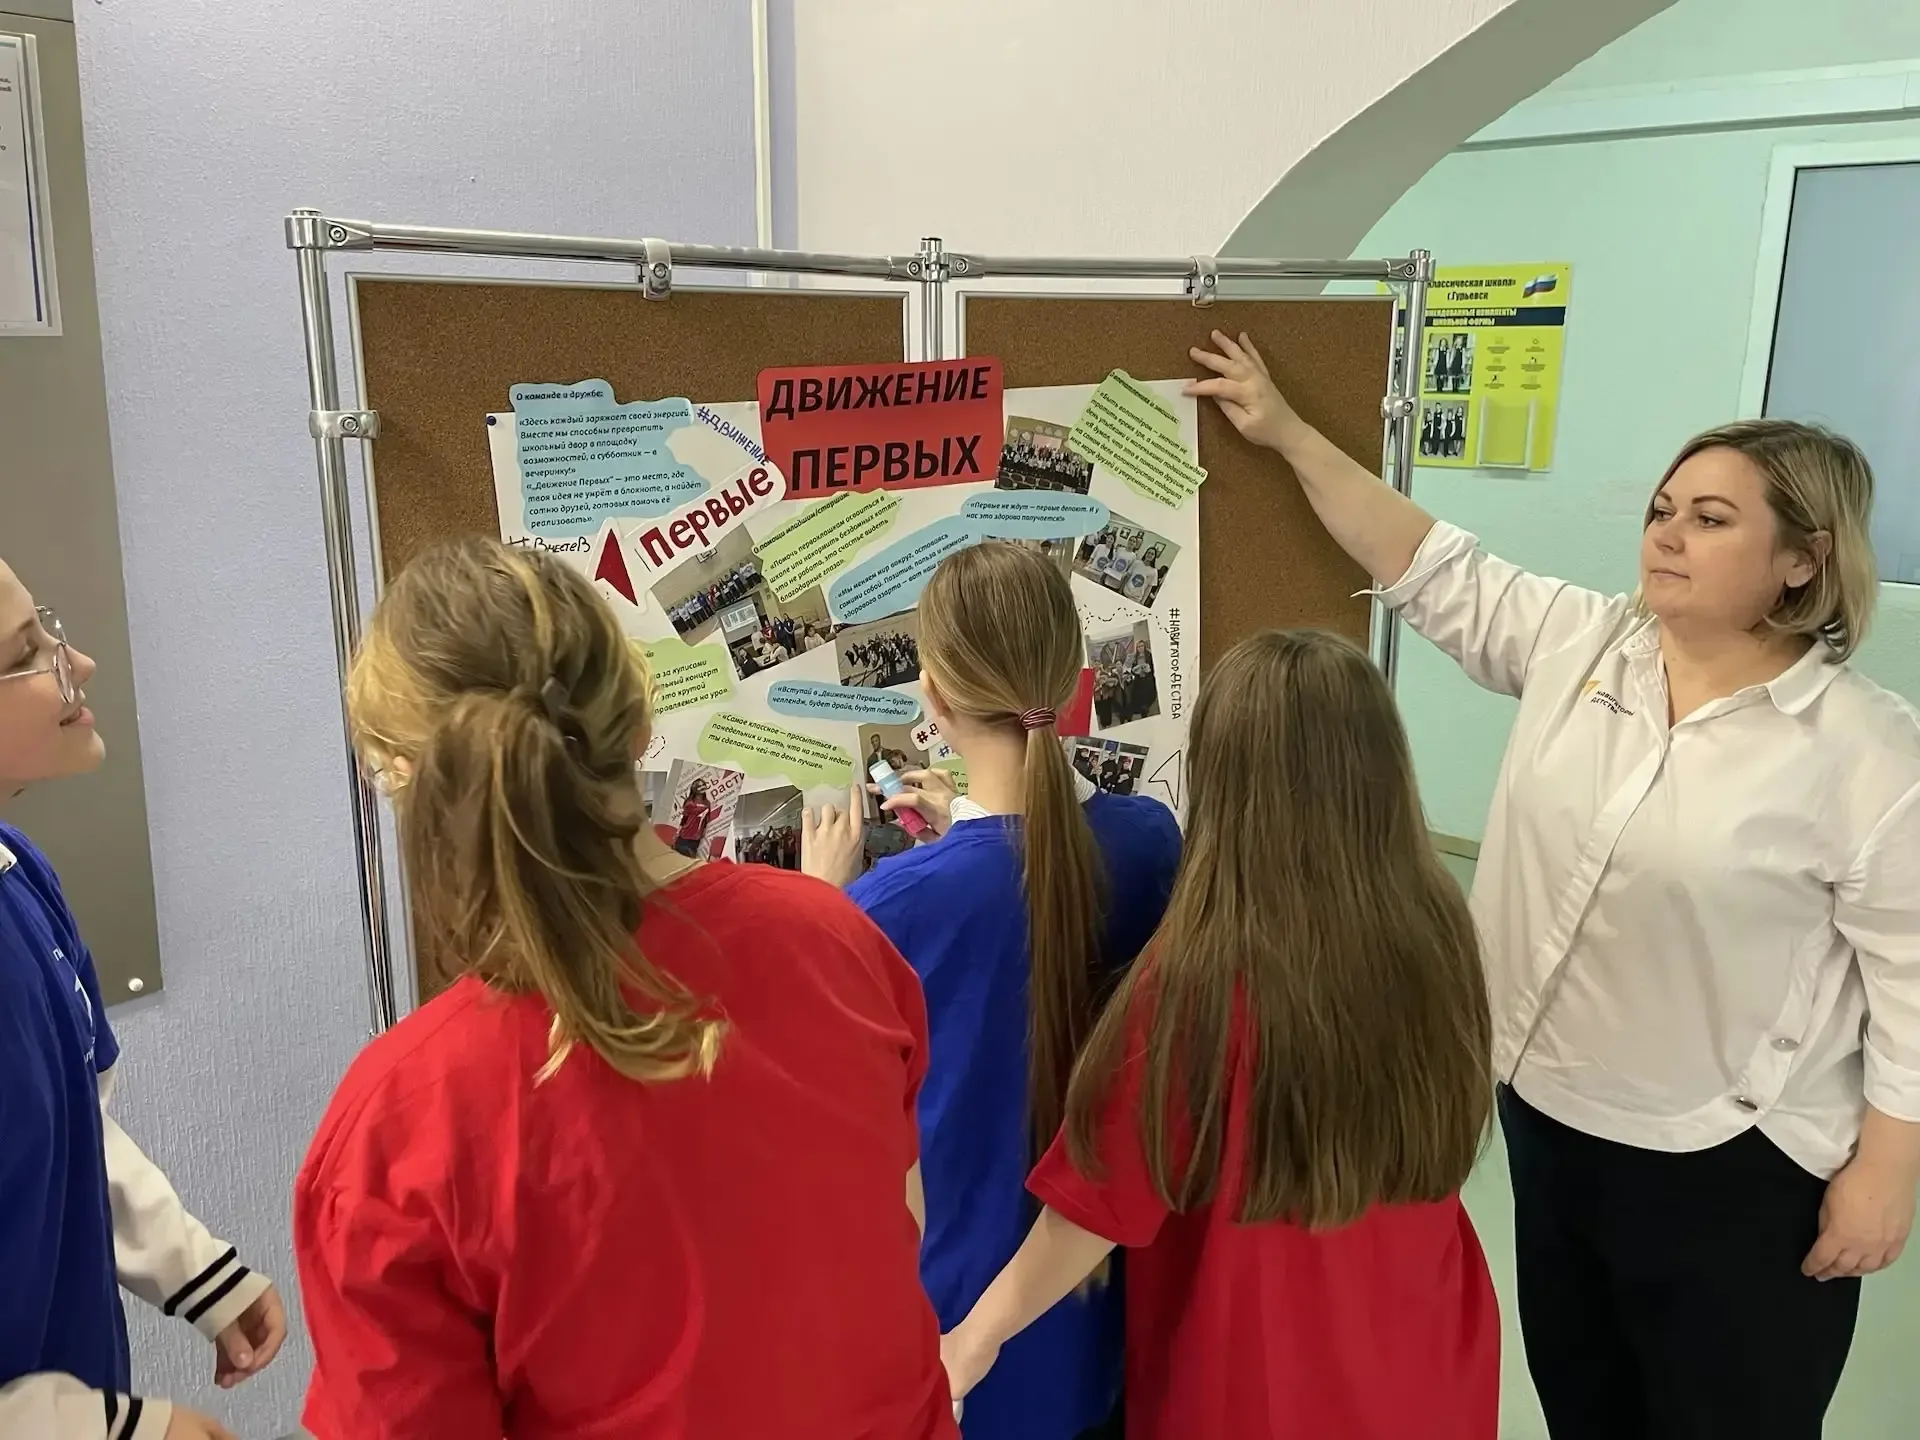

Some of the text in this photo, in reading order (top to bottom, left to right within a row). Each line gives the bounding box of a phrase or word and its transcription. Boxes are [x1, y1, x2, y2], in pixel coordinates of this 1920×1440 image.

[524, 391, 560, 400] команде
[570, 390, 603, 400] дружбе:
[766, 366, 991, 422] ДВИЖЕНИЕ
[520, 417, 548, 425] «Здесь
[551, 415, 583, 424] каждый
[586, 414, 626, 424] заряжает
[629, 411, 651, 420] своей
[521, 430, 553, 439] Вместе
[570, 426, 609, 436] способны
[612, 425, 663, 435] превратить
[697, 406, 769, 466] #ДВИЖЕНИЕ
[523, 442, 565, 451] школьный
[568, 440, 587, 450] двор
[596, 438, 637, 449] площадку
[524, 452, 588, 465] возможностей,
[597, 449, 641, 461] субботник
[792, 436, 981, 491] ПЕРВЫХ
[525, 468, 575, 478] вечеринку!»
[642, 473, 669, 482] место,
[671, 470, 684, 478] где
[528, 494, 550, 502] твоя
[552, 491, 572, 500] идея
[586, 488, 612, 499] умрёт
[621, 484, 662, 496] блокноте,
[671, 481, 701, 490] найдёт
[530, 506, 558, 514] сотню
[561, 502, 591, 513] друзей,
[593, 501, 629, 509] готовых
[631, 498, 659, 506] помочь
[1010, 503, 1028, 511] ждут
[799, 521, 844, 553] первоклашкам
[846, 499, 879, 523] освоиться
[994, 513, 1020, 521] здорово
[760, 532, 785, 551] помощи
[770, 501, 897, 582] школе или накормить бездомных котят
[775, 581, 788, 591] это
[798, 558, 824, 578] работа,
[825, 551, 837, 561] это
[838, 535, 863, 553] счастье
[865, 519, 888, 537] видеть
[854, 574, 876, 589] меняем
[878, 566, 890, 577] мир
[891, 553, 914, 570] вокруг,
[915, 534, 948, 555] оставаясь
[839, 593, 862, 609] самими
[864, 580, 883, 595] собой.
[884, 564, 913, 585] Позитив,
[914, 552, 936, 568] польза
[943, 534, 969, 552] немного
[780, 572, 822, 602] благодарные
[844, 565, 936, 620] здорового азарта вот наш
[661, 682, 706, 700] это крутой
[773, 695, 807, 706] челлендж,
[809, 699, 830, 709] будет
[832, 701, 853, 711] драйв,
[855, 704, 875, 713] будут
[892, 697, 913, 706] будет
[712, 722, 755, 740] понедельник
[763, 738, 784, 749] знать,
[787, 744, 800, 752] что
[811, 749, 828, 760] этой
[829, 754, 852, 766] неделе
[748, 722, 779, 734] классное
[787, 732, 831, 751] просыпаться
[722, 737, 754, 751] сделаешь
[756, 746, 780, 758] чей-то
[781, 753, 796, 763] день
